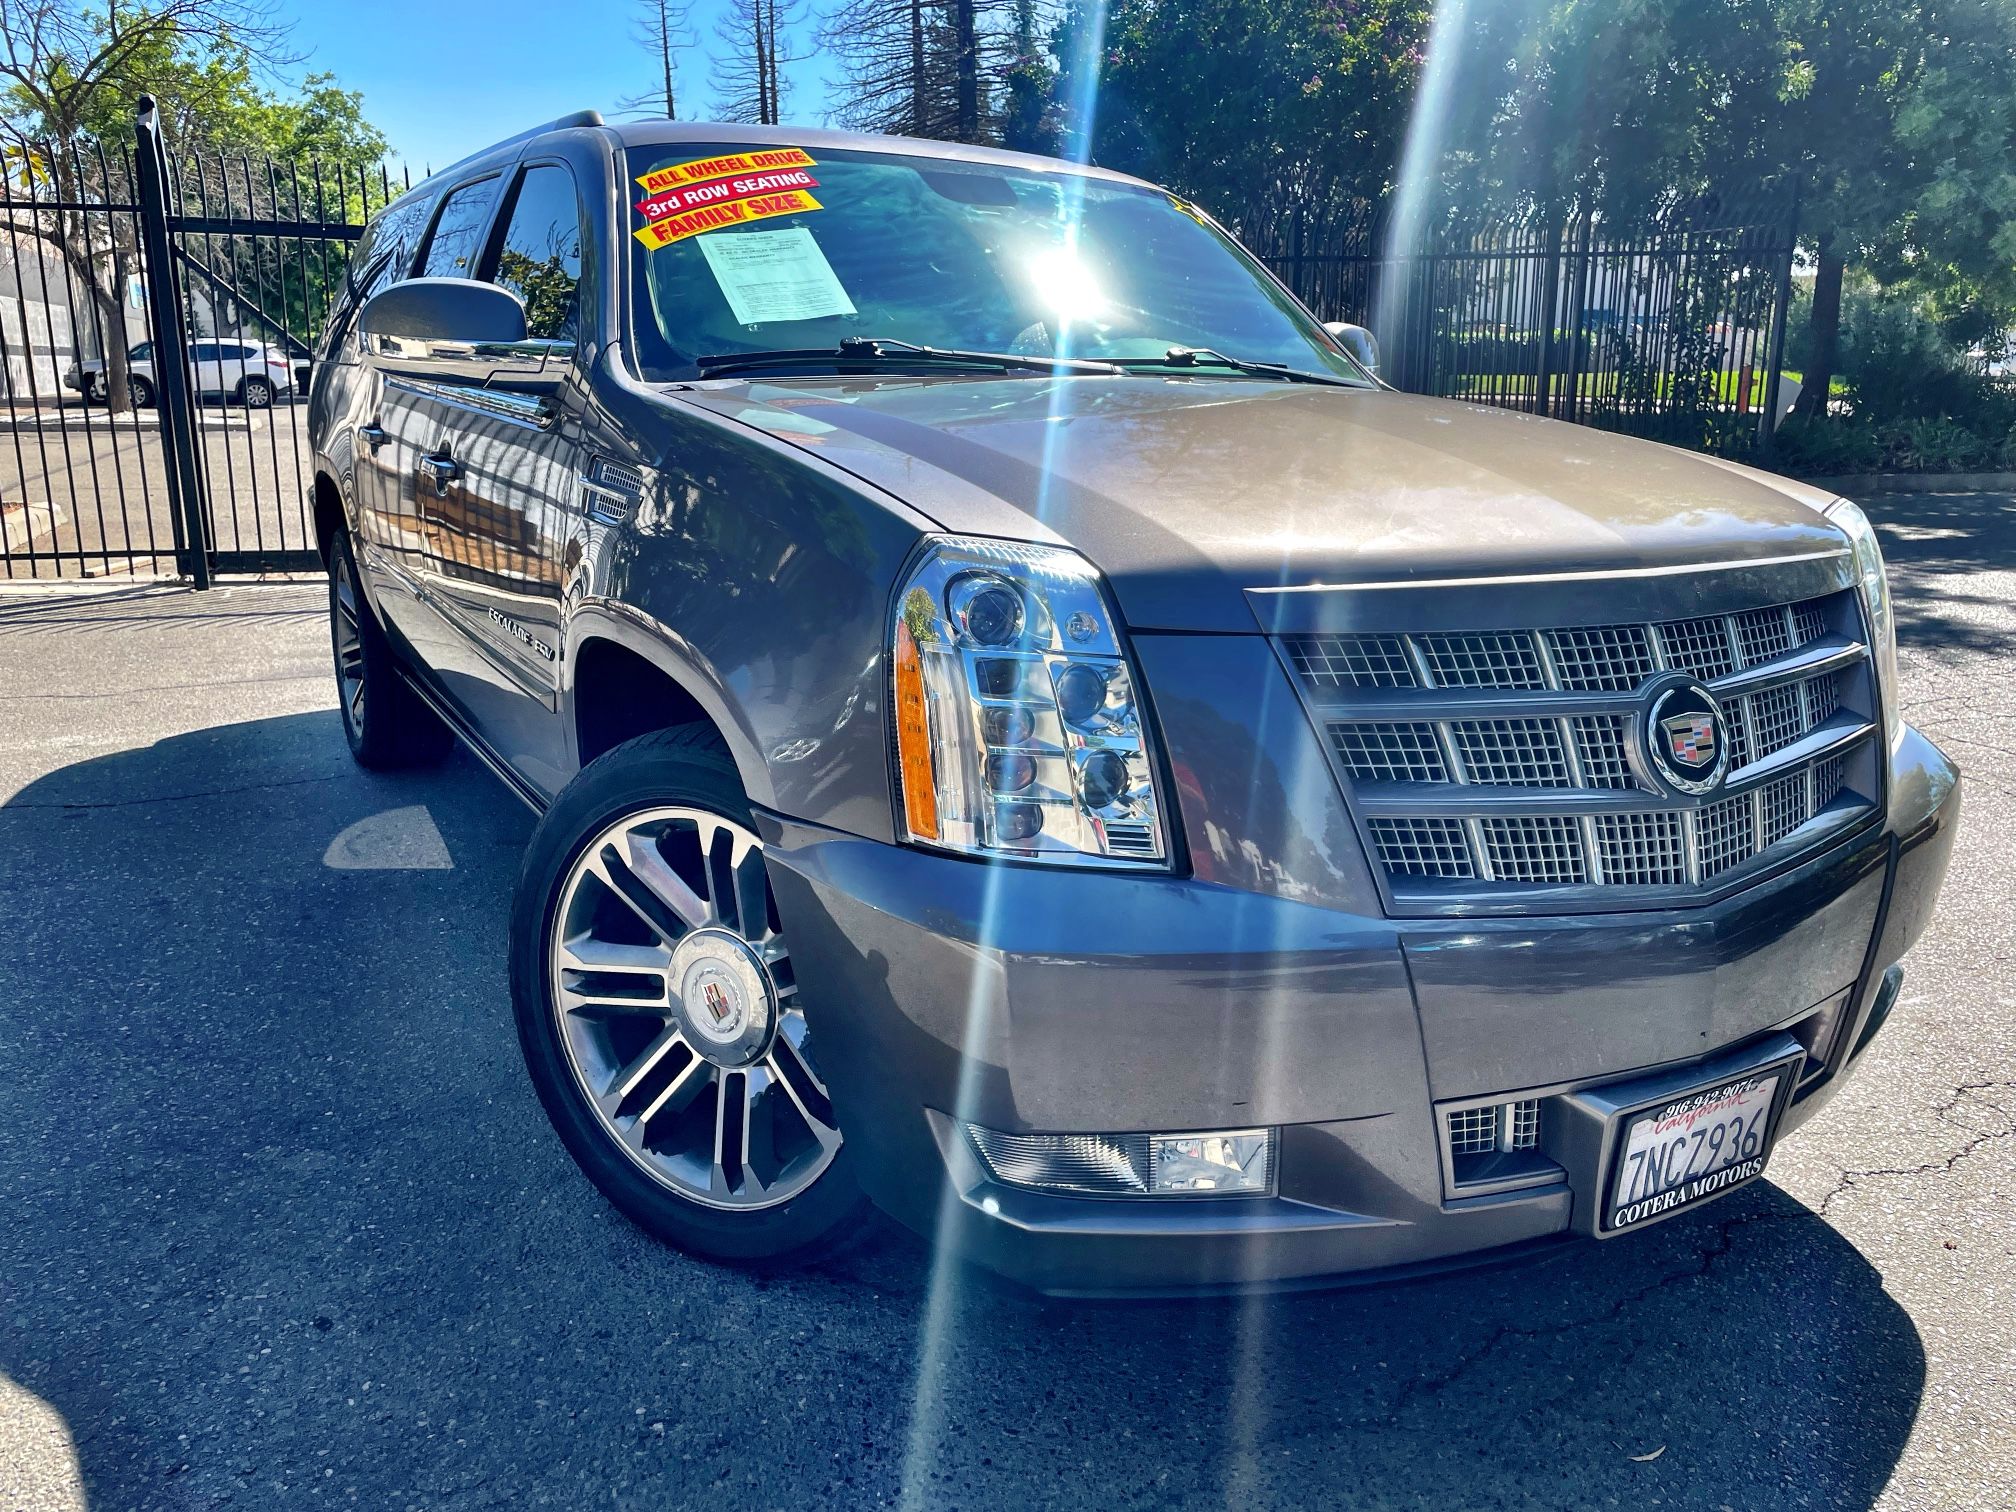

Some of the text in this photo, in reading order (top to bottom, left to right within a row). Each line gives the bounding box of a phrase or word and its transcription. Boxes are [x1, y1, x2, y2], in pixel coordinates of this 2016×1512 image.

[646, 151, 809, 190] ALL WHEEL DRIVE
[646, 171, 811, 218] 3rd ROW SEATING
[651, 193, 805, 242] FAMILY SIZE
[1666, 1078, 1753, 1119] 916-942-9074
[1627, 1107, 1764, 1203] 7NCZ936
[1614, 1158, 1763, 1228] COTERA MOTORS
